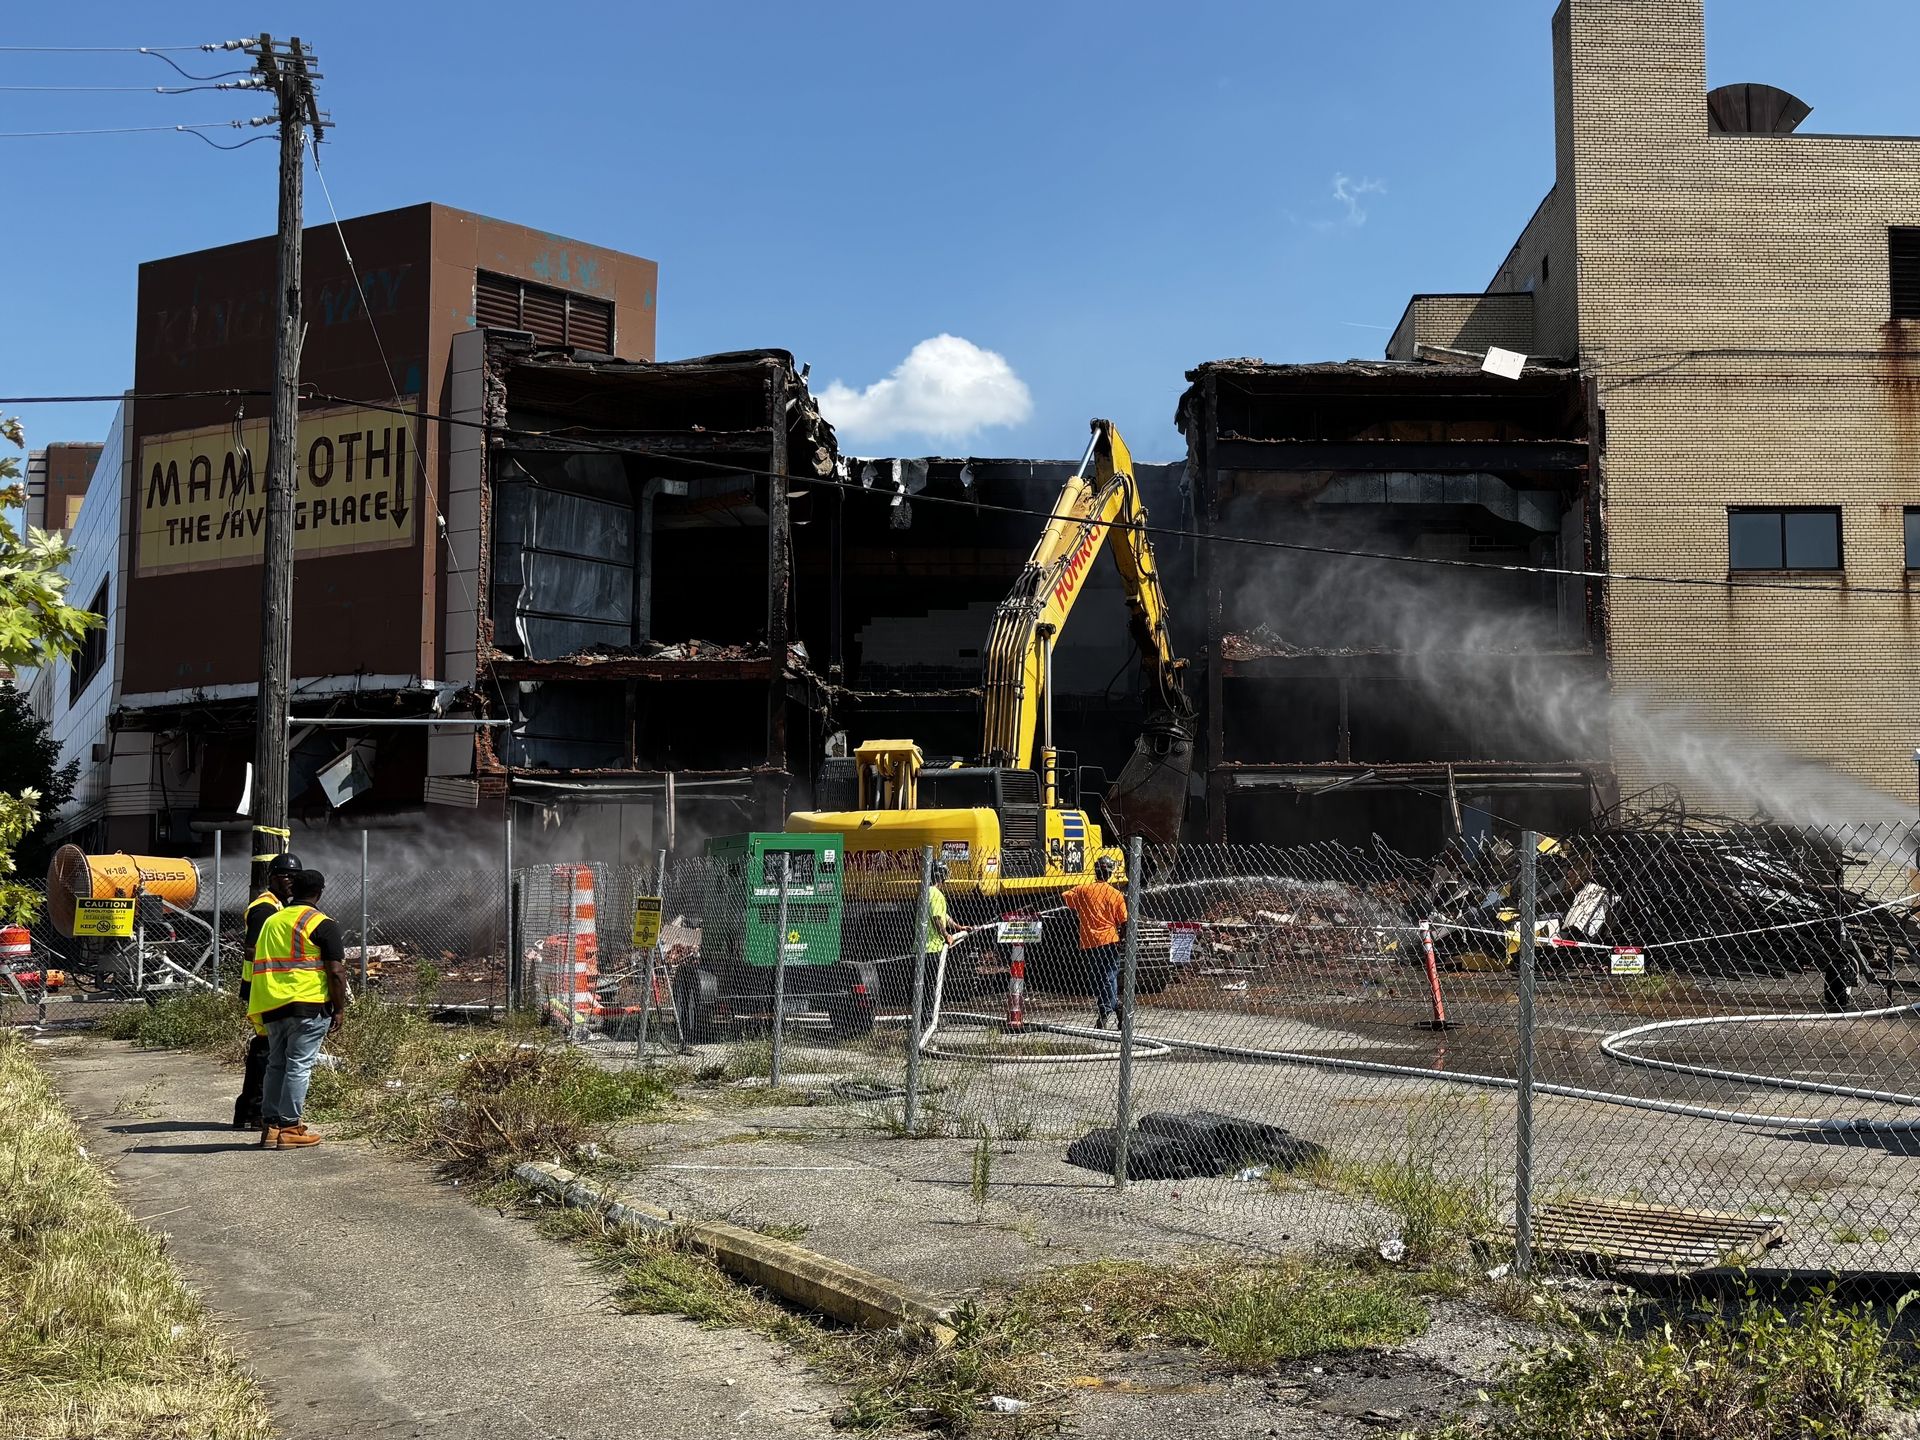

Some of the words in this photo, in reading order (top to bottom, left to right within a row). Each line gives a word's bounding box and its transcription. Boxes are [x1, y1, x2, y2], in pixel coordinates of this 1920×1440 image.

[147, 428, 391, 509] MAMOTH
[166, 515, 210, 546] THE
[216, 501, 306, 541] SAVG
[313, 491, 388, 529] PLACE
[144, 871, 186, 882] BOSS
